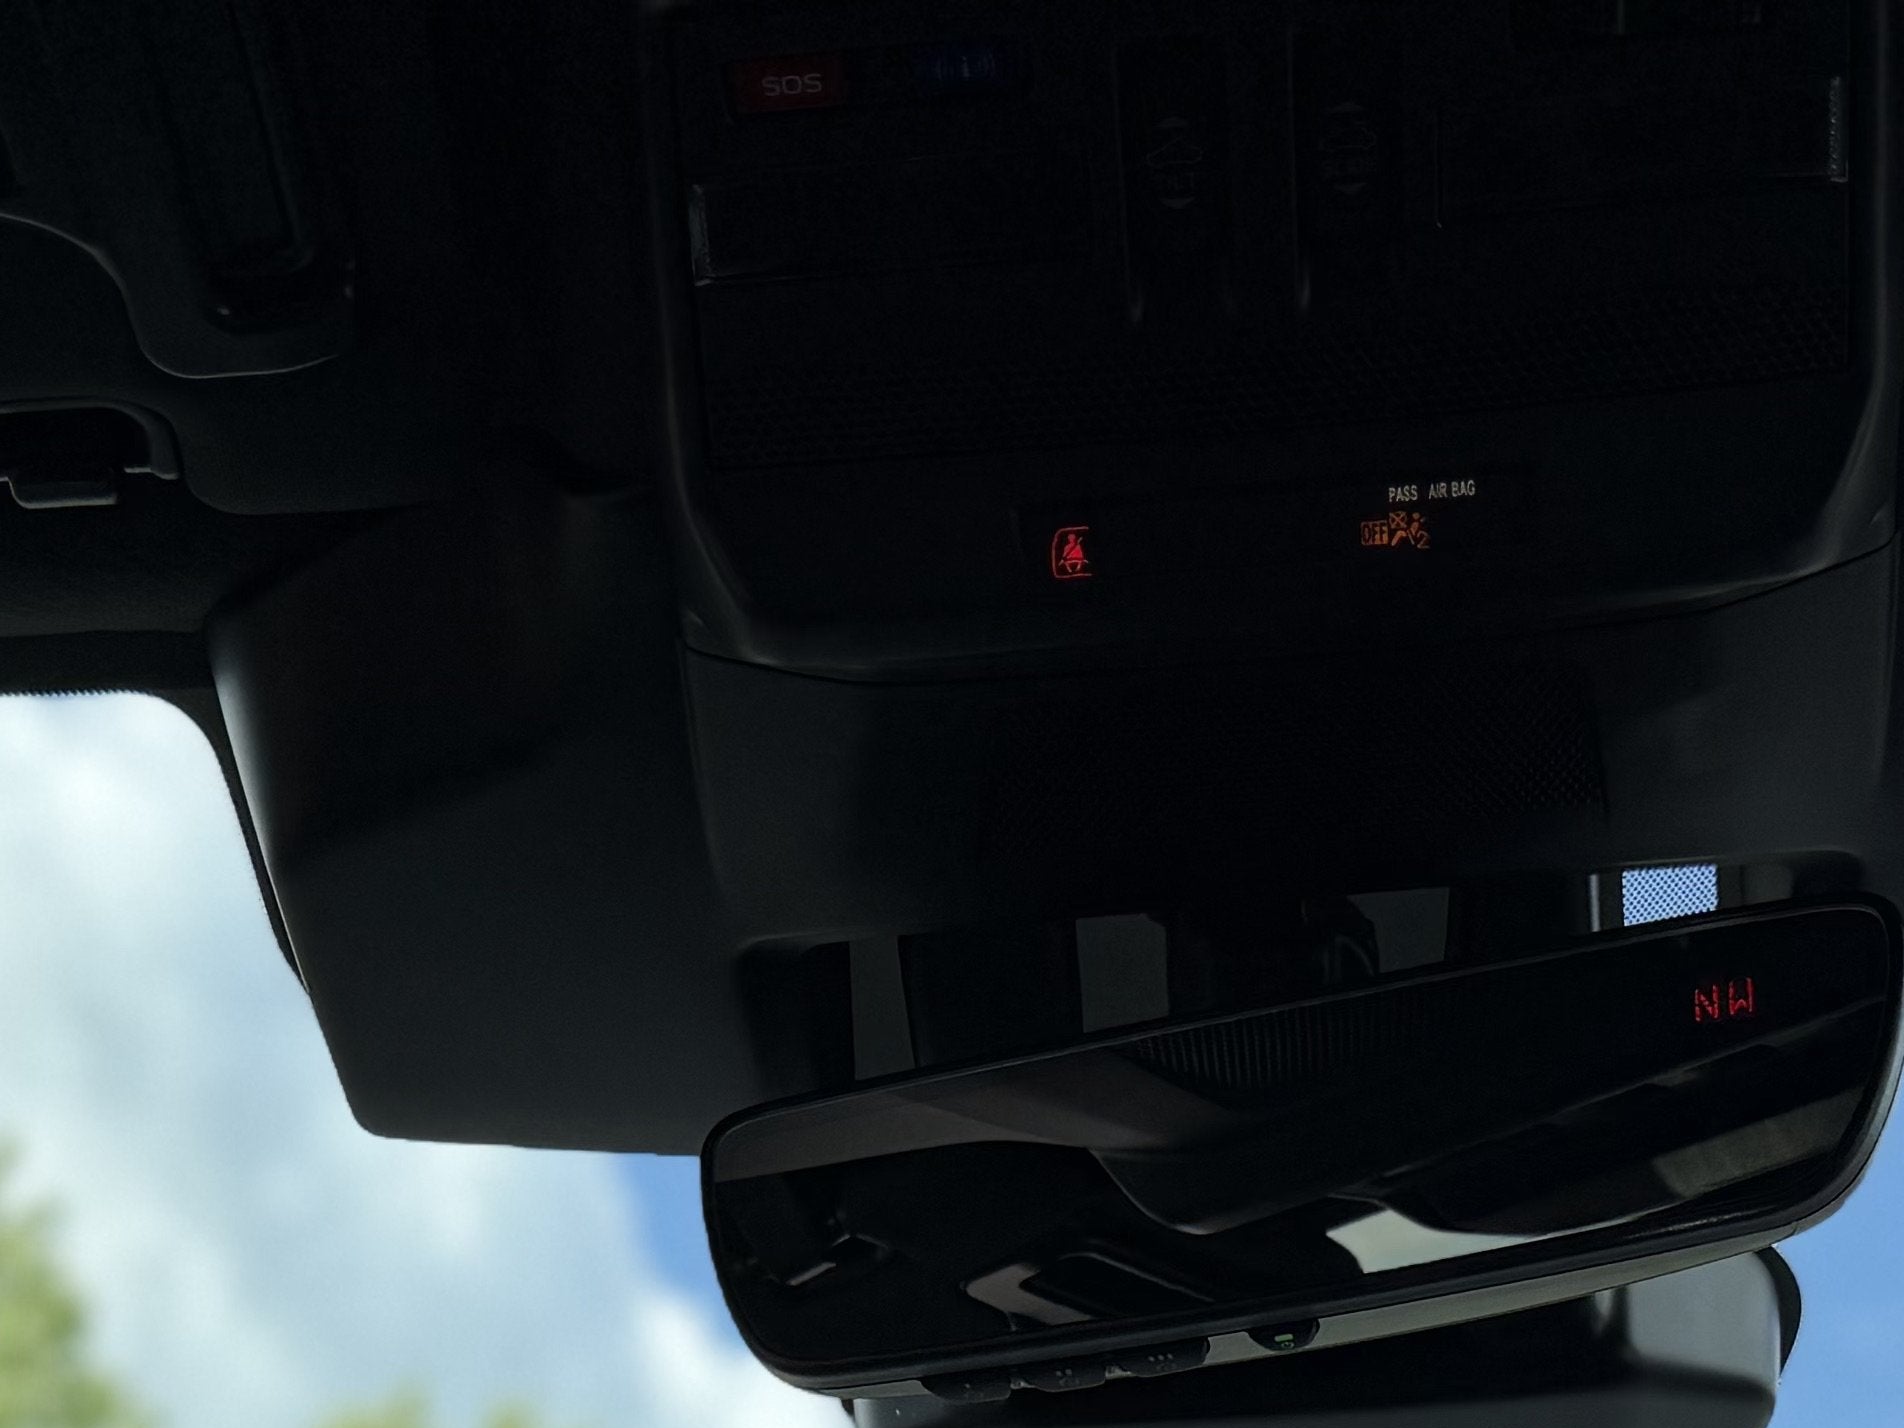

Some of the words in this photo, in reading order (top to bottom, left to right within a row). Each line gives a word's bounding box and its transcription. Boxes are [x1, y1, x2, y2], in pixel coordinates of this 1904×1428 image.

[761, 73, 823, 97] SOS
[1388, 484, 1419, 503] PASS
[1428, 482, 1448, 500] AIR
[1450, 479, 1476, 498] BAG
[1692, 975, 1757, 1024] NW
